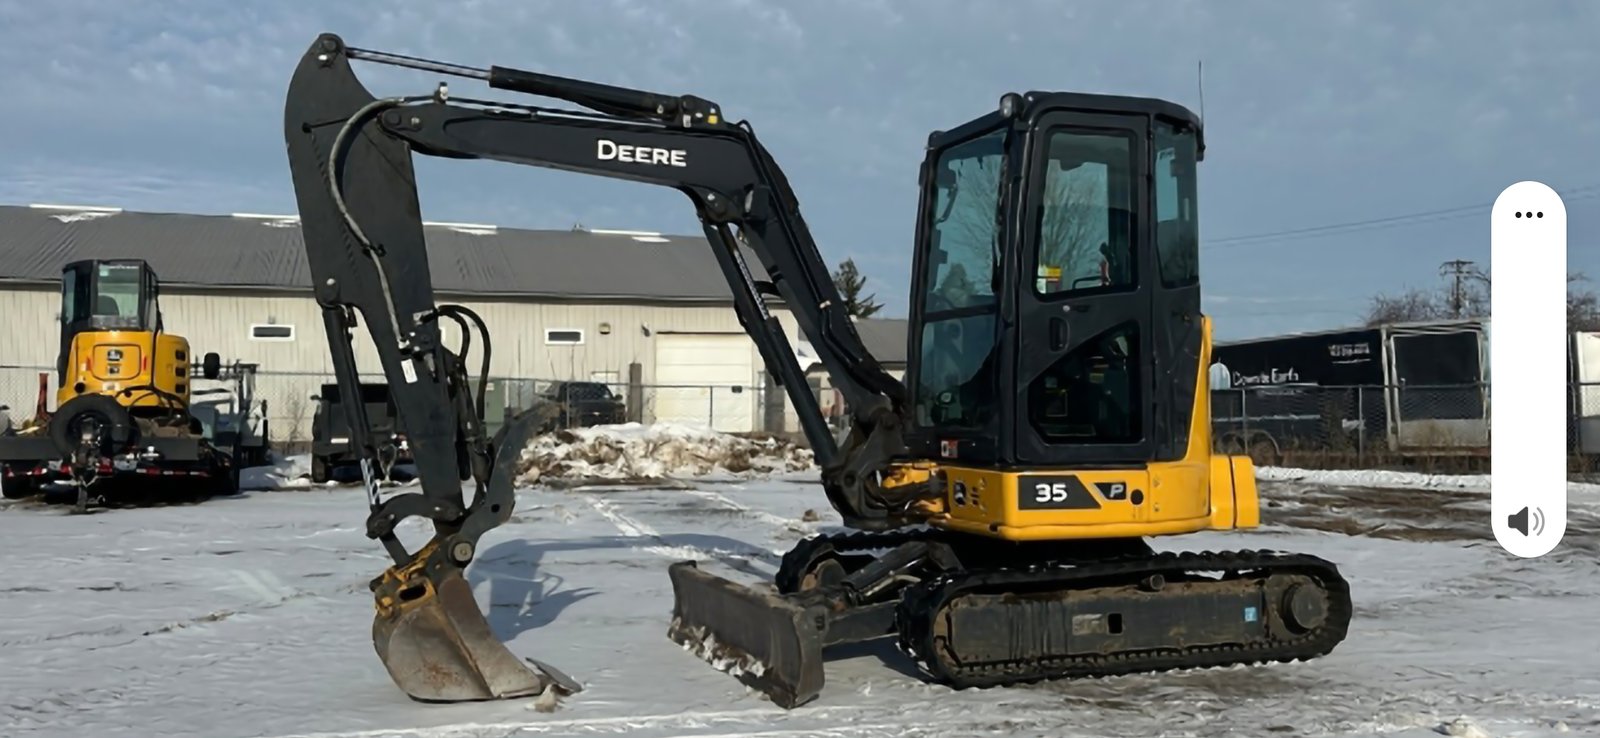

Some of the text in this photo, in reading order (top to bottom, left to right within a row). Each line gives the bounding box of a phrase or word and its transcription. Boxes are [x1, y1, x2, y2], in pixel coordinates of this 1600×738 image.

[597, 139, 687, 167] DEERE
[1035, 483, 1067, 502] 35
[1110, 484, 1124, 498] P
